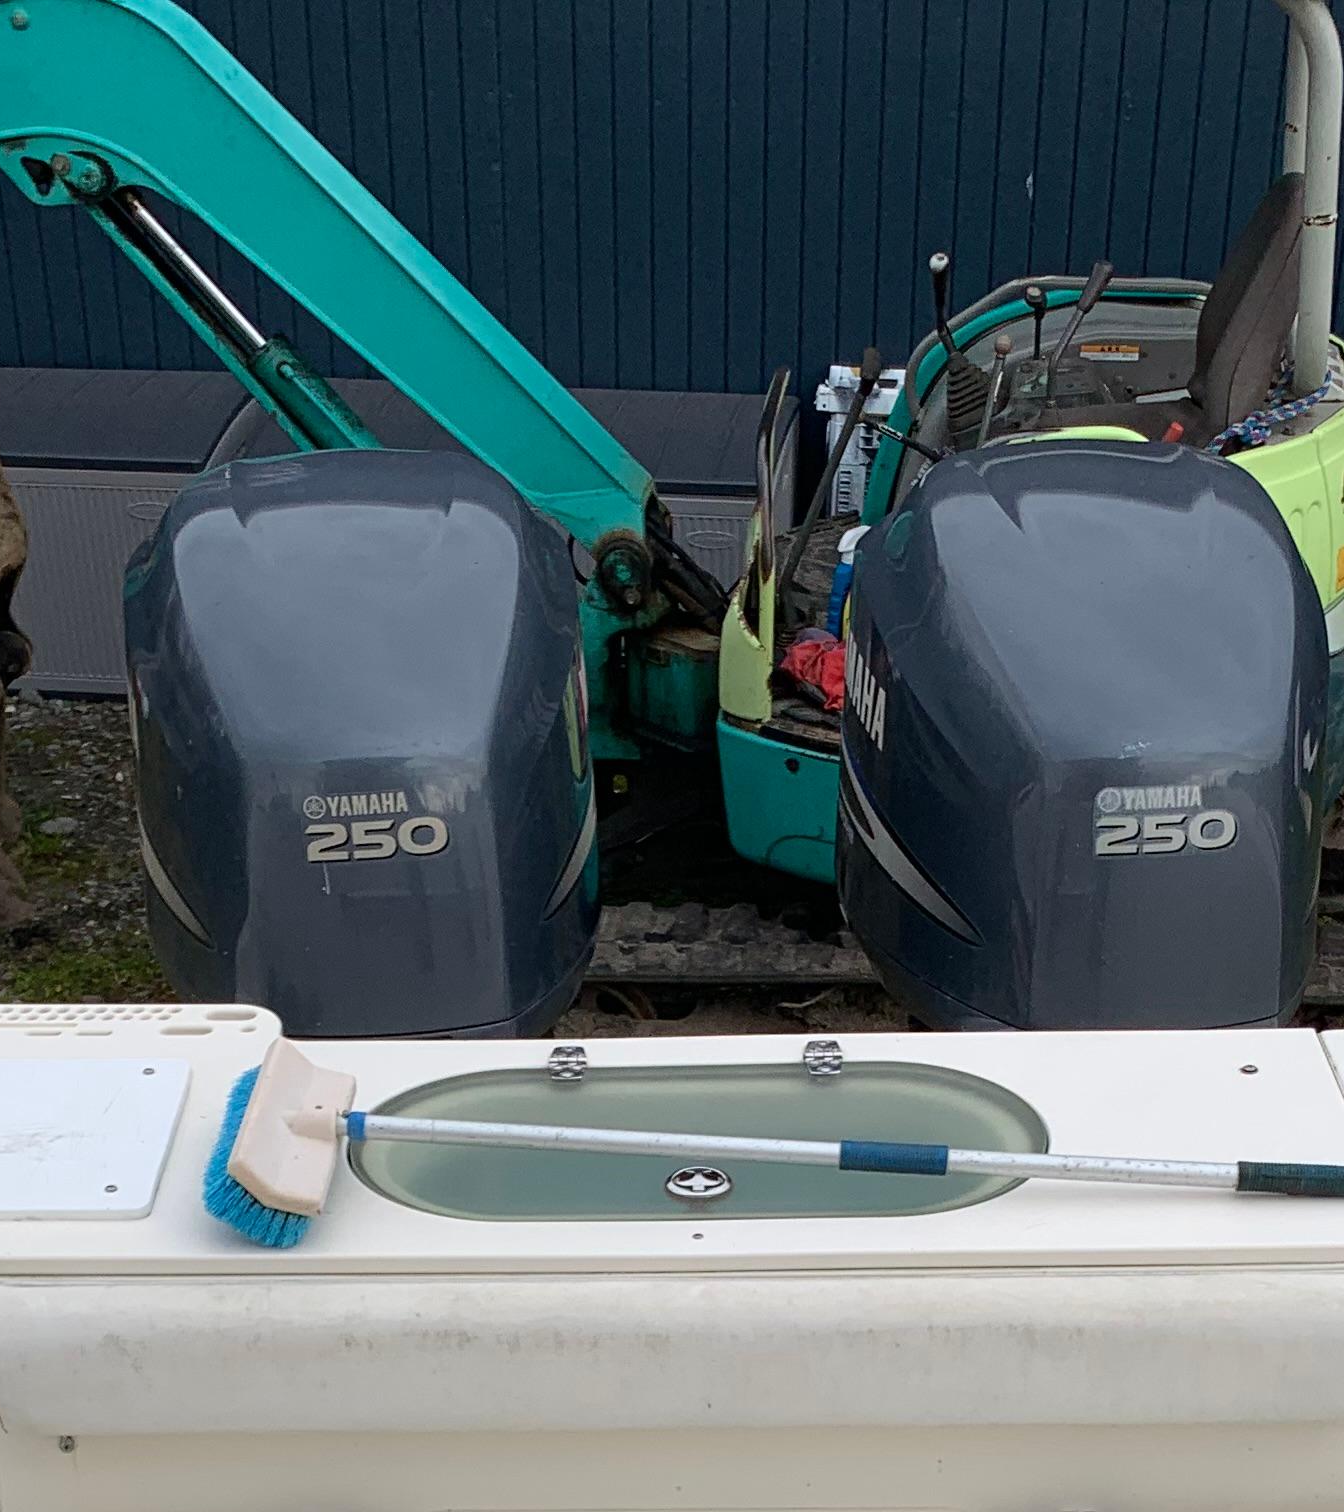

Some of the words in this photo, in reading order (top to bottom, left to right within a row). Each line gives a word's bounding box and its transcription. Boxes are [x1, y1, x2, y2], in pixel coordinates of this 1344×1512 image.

[326, 791, 408, 817] YAMAHA
[1122, 785, 1202, 810] YAMAHA
[304, 816, 449, 863] 250
[1096, 810, 1237, 856] 250
